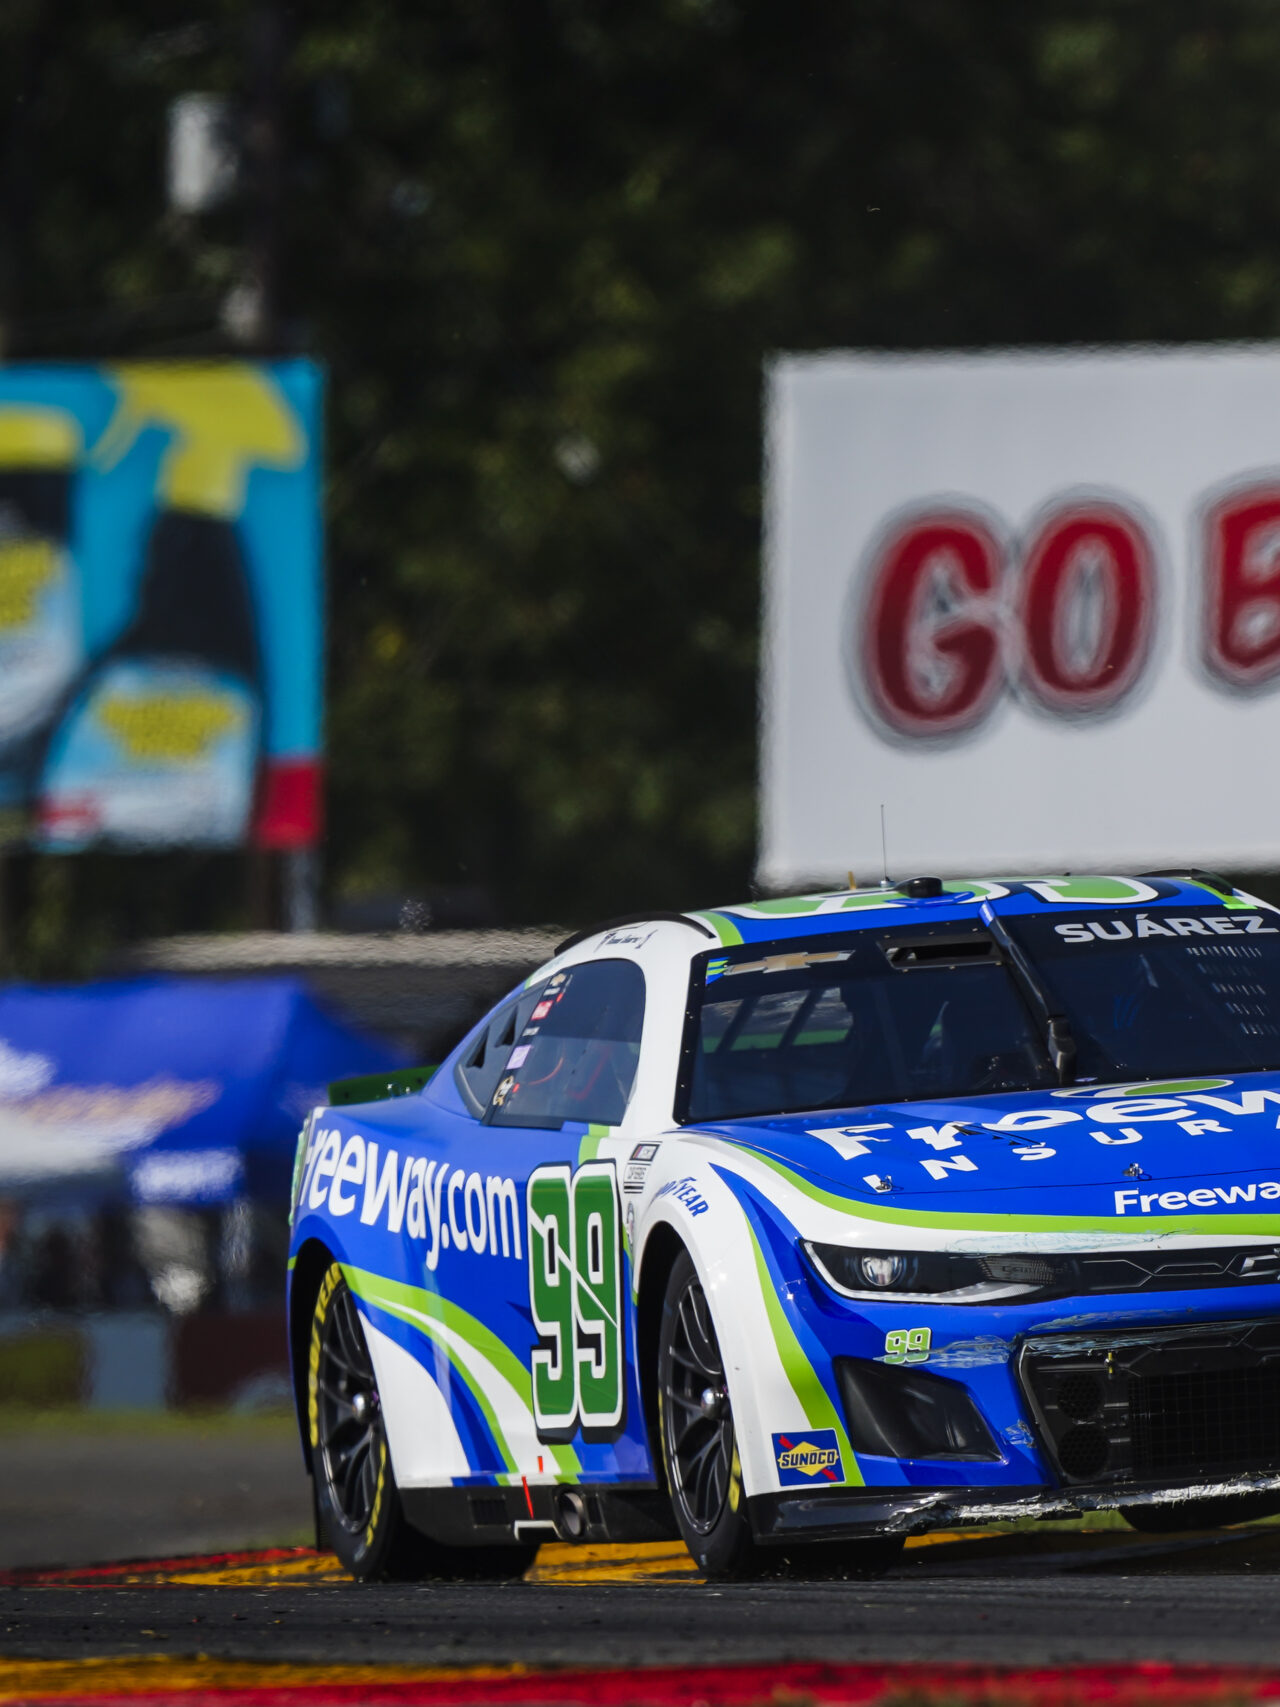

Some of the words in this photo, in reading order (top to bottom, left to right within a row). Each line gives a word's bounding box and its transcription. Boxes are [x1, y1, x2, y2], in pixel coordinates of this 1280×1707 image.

[858, 502, 1160, 740] GO
[1054, 914, 1280, 944] SUÁREZ
[299, 1106, 523, 1271] Freeway.com
[526, 1159, 624, 1438] 99
[884, 1326, 932, 1364] 99
[780, 1450, 837, 1469] SUNOCO
